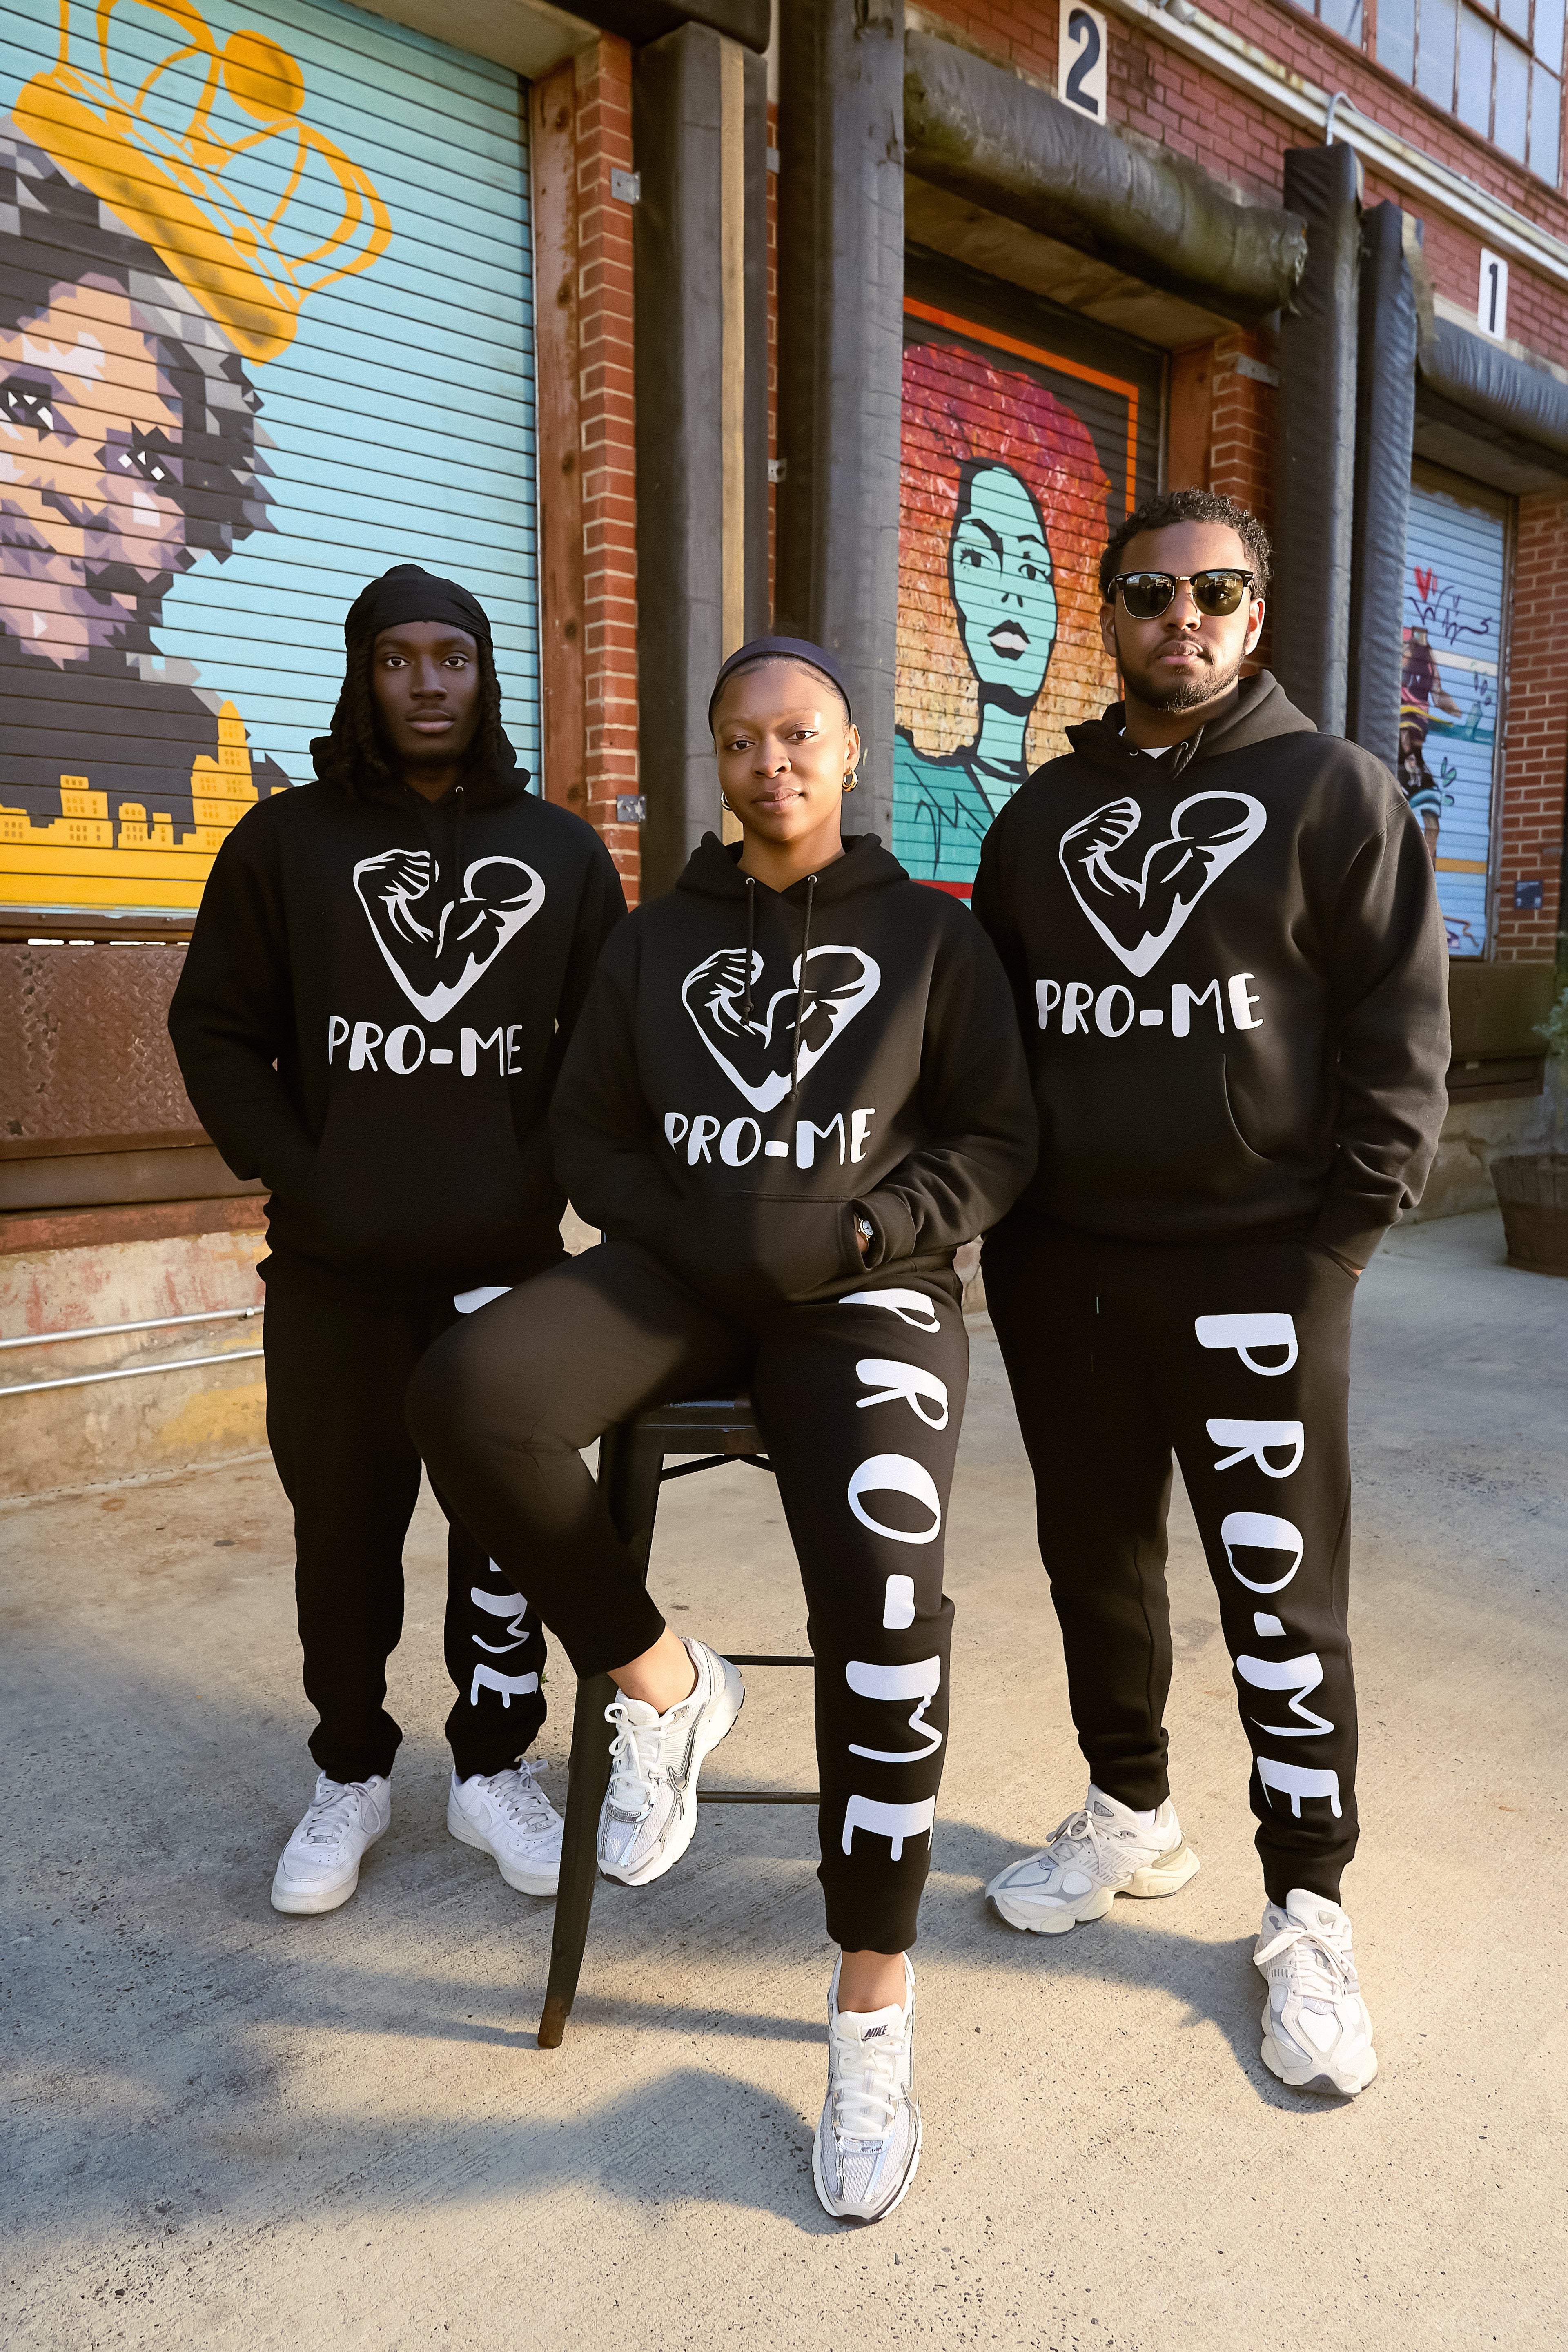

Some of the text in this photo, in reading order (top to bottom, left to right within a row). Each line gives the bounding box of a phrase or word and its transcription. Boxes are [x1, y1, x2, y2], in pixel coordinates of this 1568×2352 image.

[1066, 8, 1100, 116] 2
[1489, 263, 1498, 332] 1
[1036, 973, 1263, 1038] PRO-ME
[328, 1015, 523, 1077] PRO-ME
[664, 1108, 875, 1169] PRO-ME
[838, 1288, 949, 1861] PRO-ME
[1194, 1313, 1342, 1818] PRO-ME
[864, 2024, 888, 2038] NIKE
